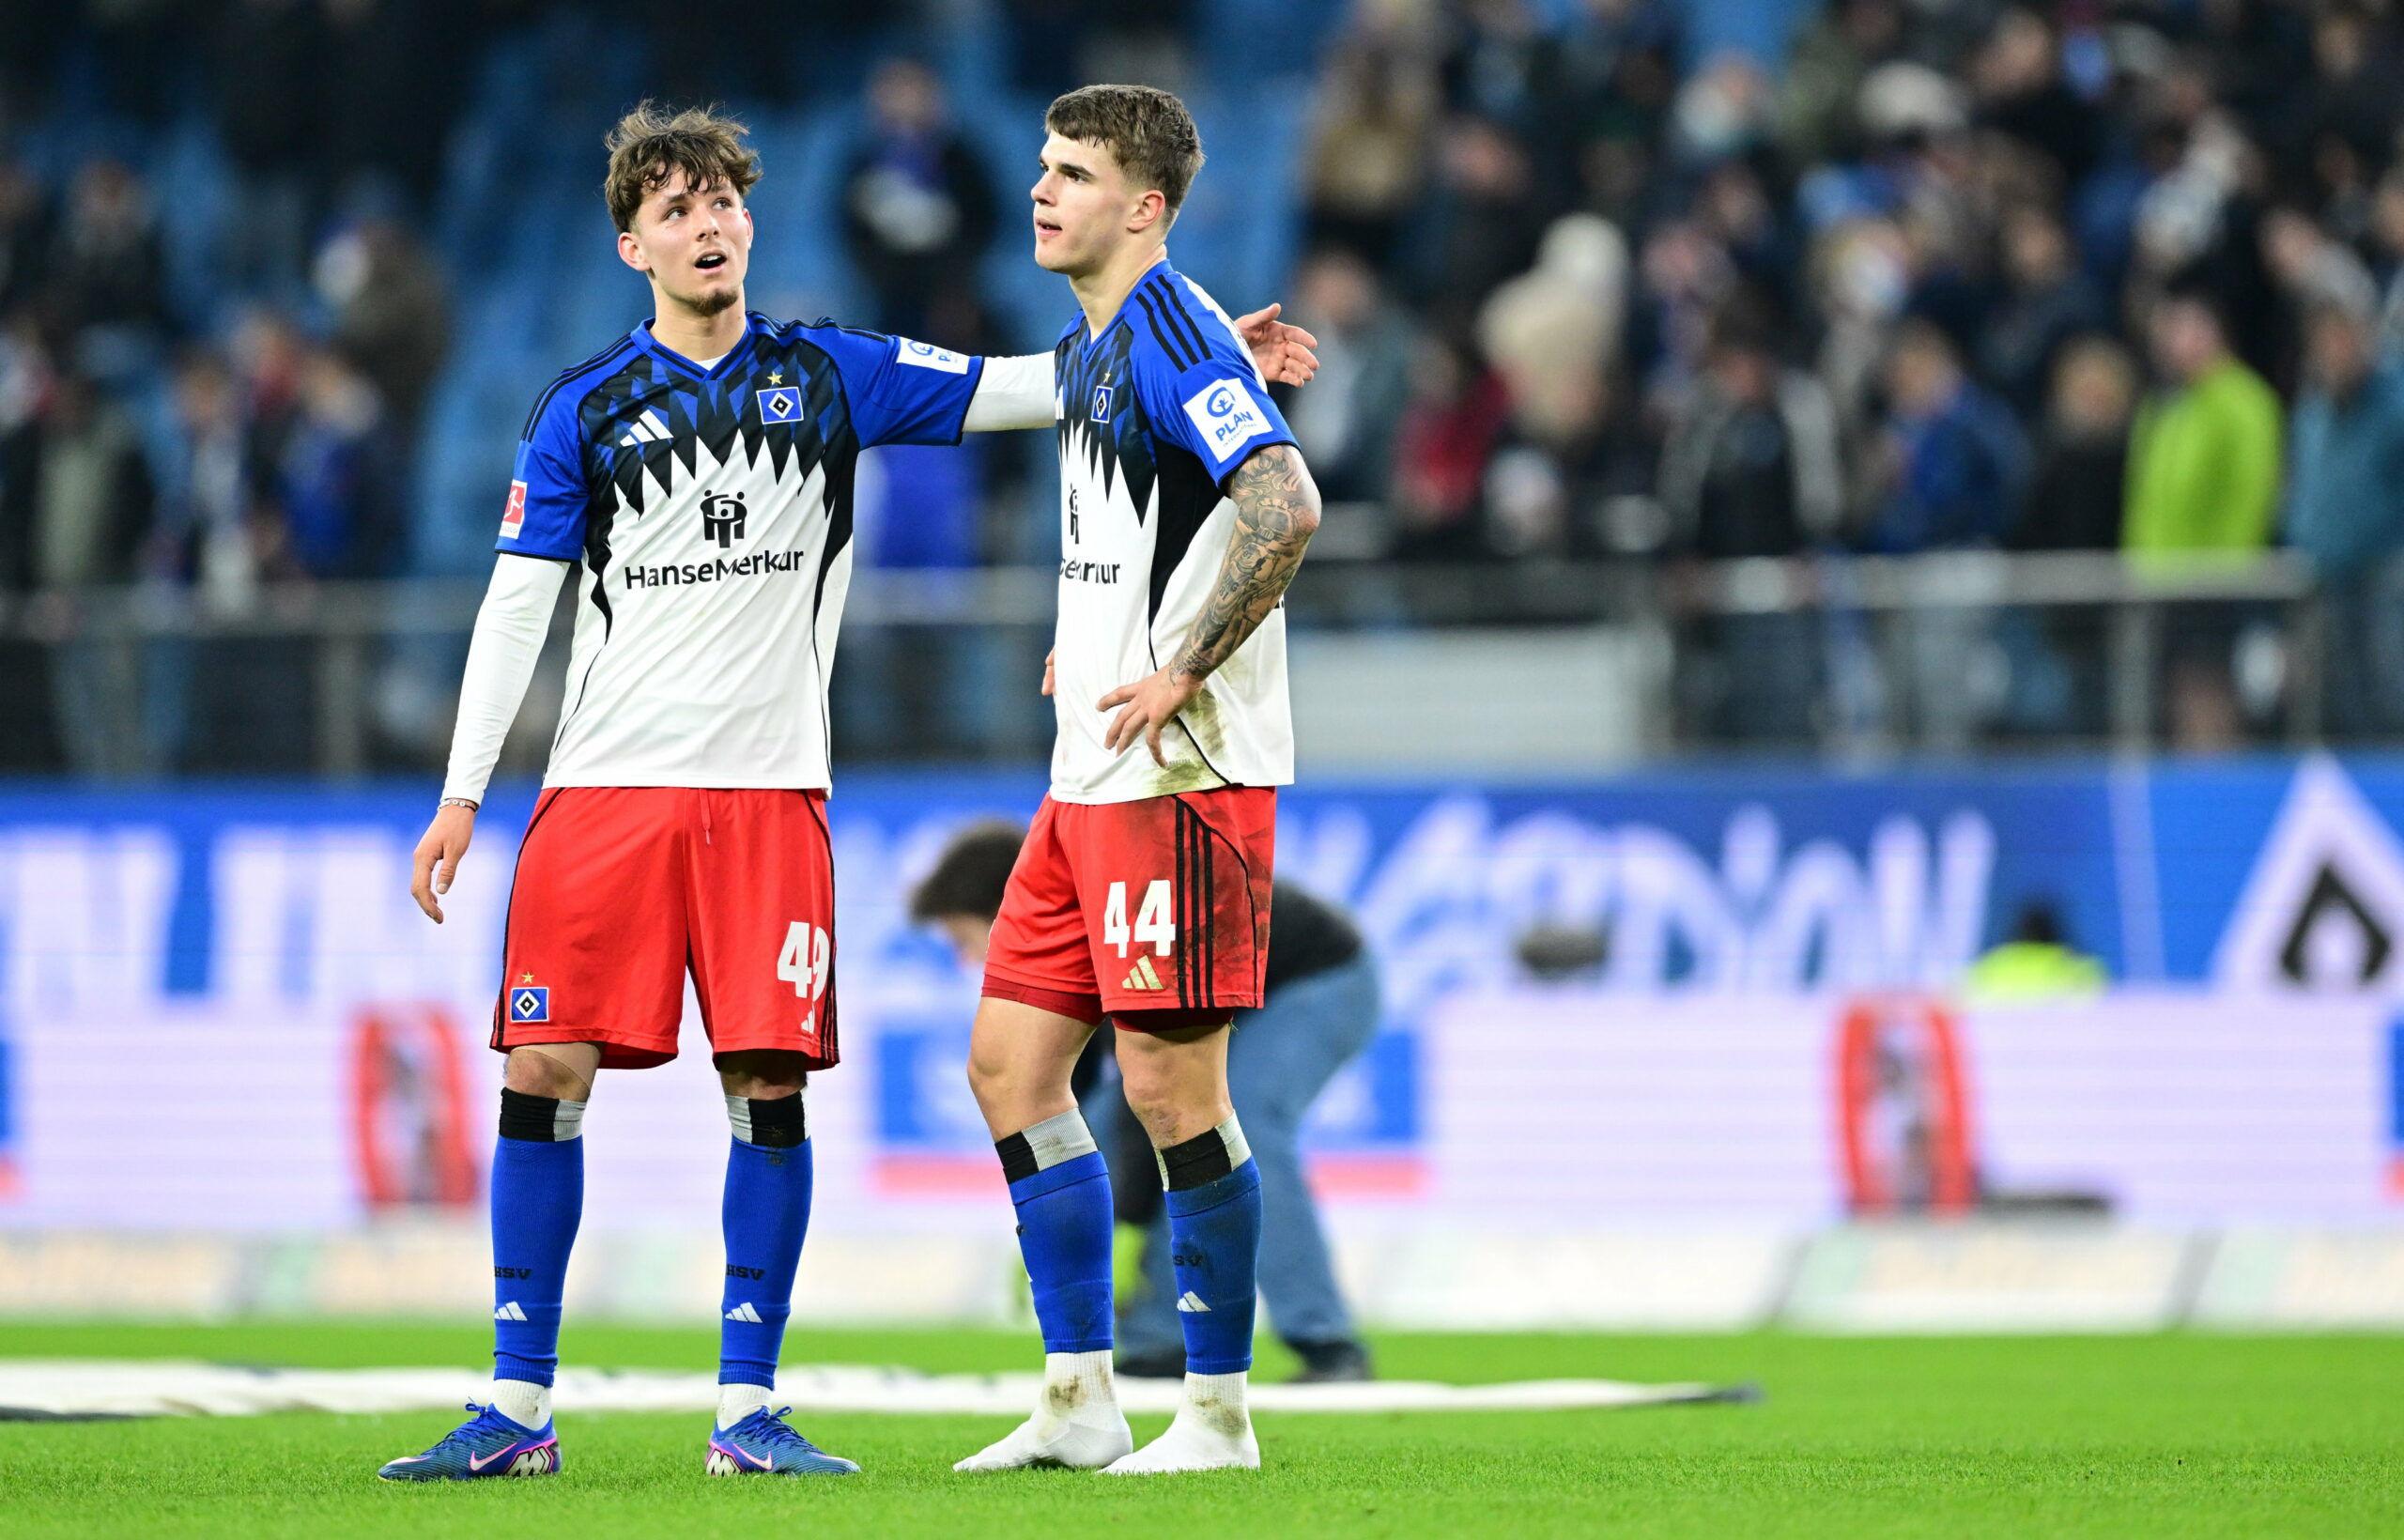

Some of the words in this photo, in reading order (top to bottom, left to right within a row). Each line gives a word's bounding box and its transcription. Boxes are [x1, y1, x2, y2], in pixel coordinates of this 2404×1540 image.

[1216, 411, 1254, 441] PLAN
[624, 550, 804, 590] HanseMerkur
[1104, 880, 1176, 958] 44
[778, 921, 830, 1002] 49
[495, 1266, 532, 1280] HSV
[727, 1264, 764, 1281] HSV
